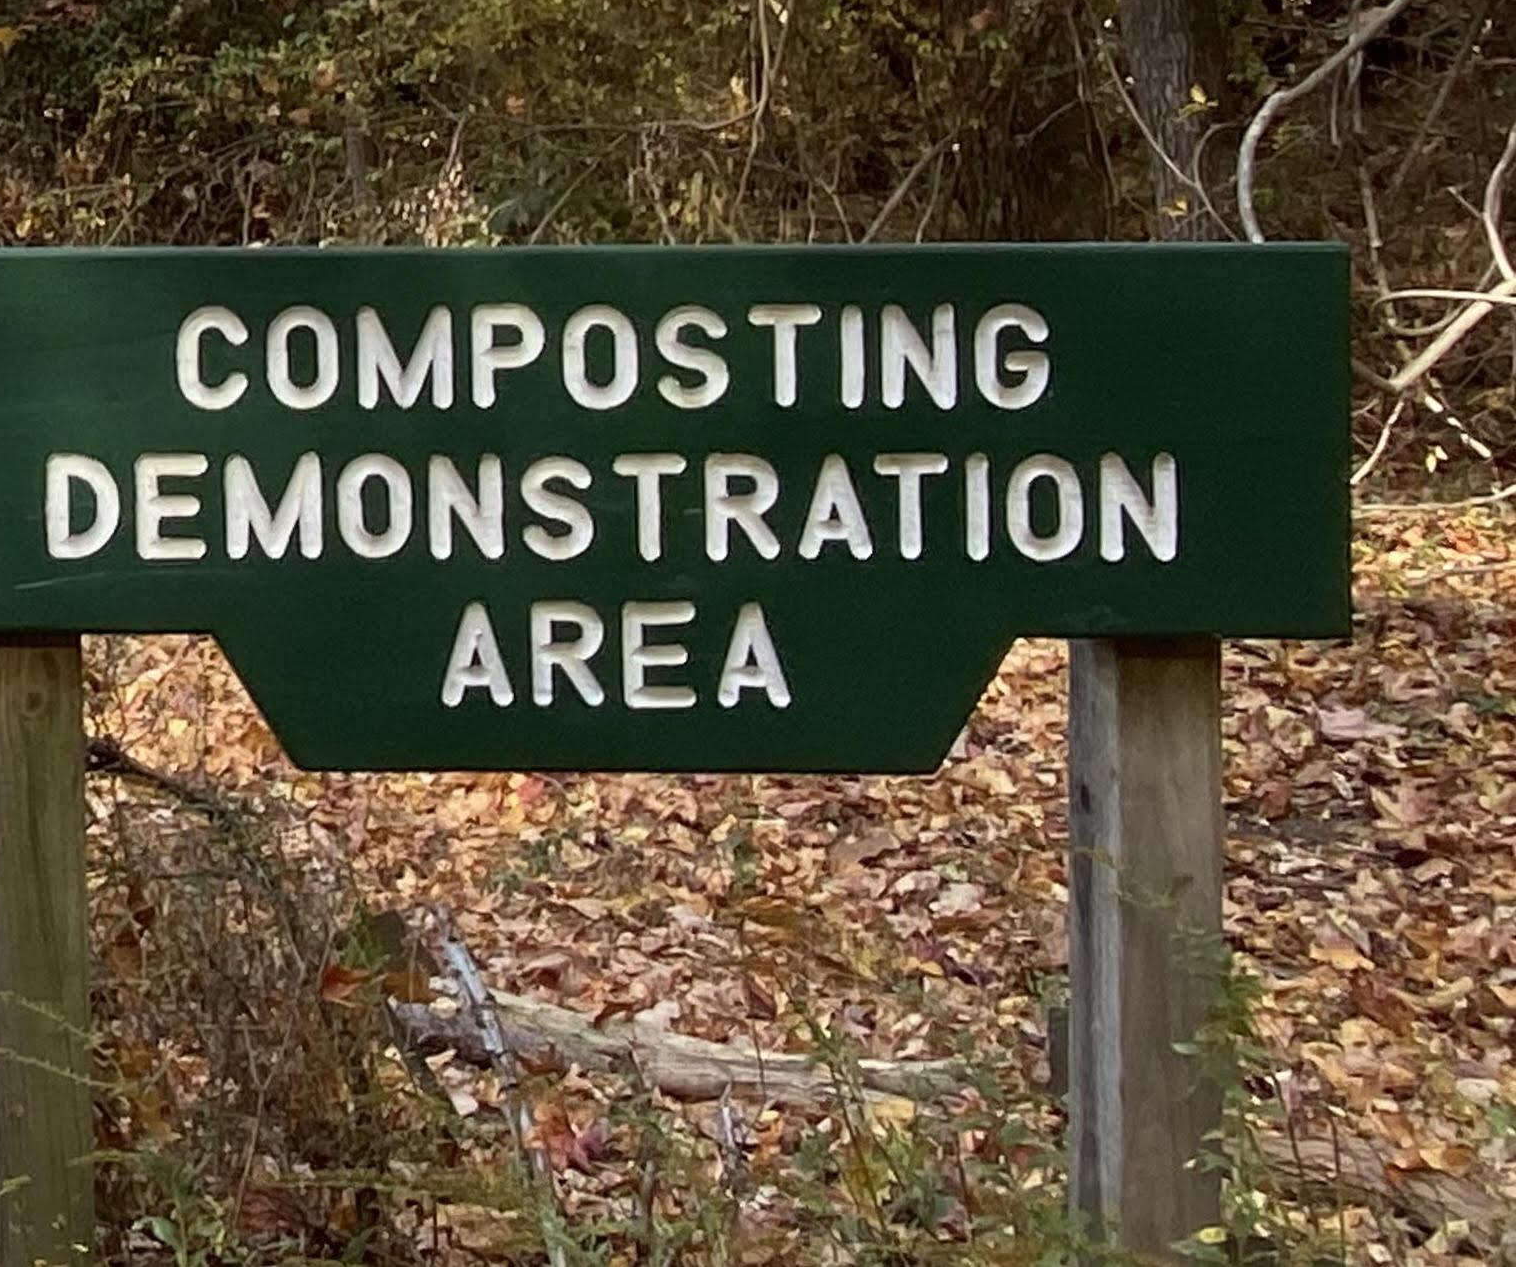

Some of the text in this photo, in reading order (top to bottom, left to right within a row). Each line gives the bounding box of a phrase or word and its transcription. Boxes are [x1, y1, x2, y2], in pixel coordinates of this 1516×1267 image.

[176, 304, 1051, 411] COMPOSTING
[44, 451, 1179, 563] DEMONSTRATION
[441, 601, 792, 710] AREA
